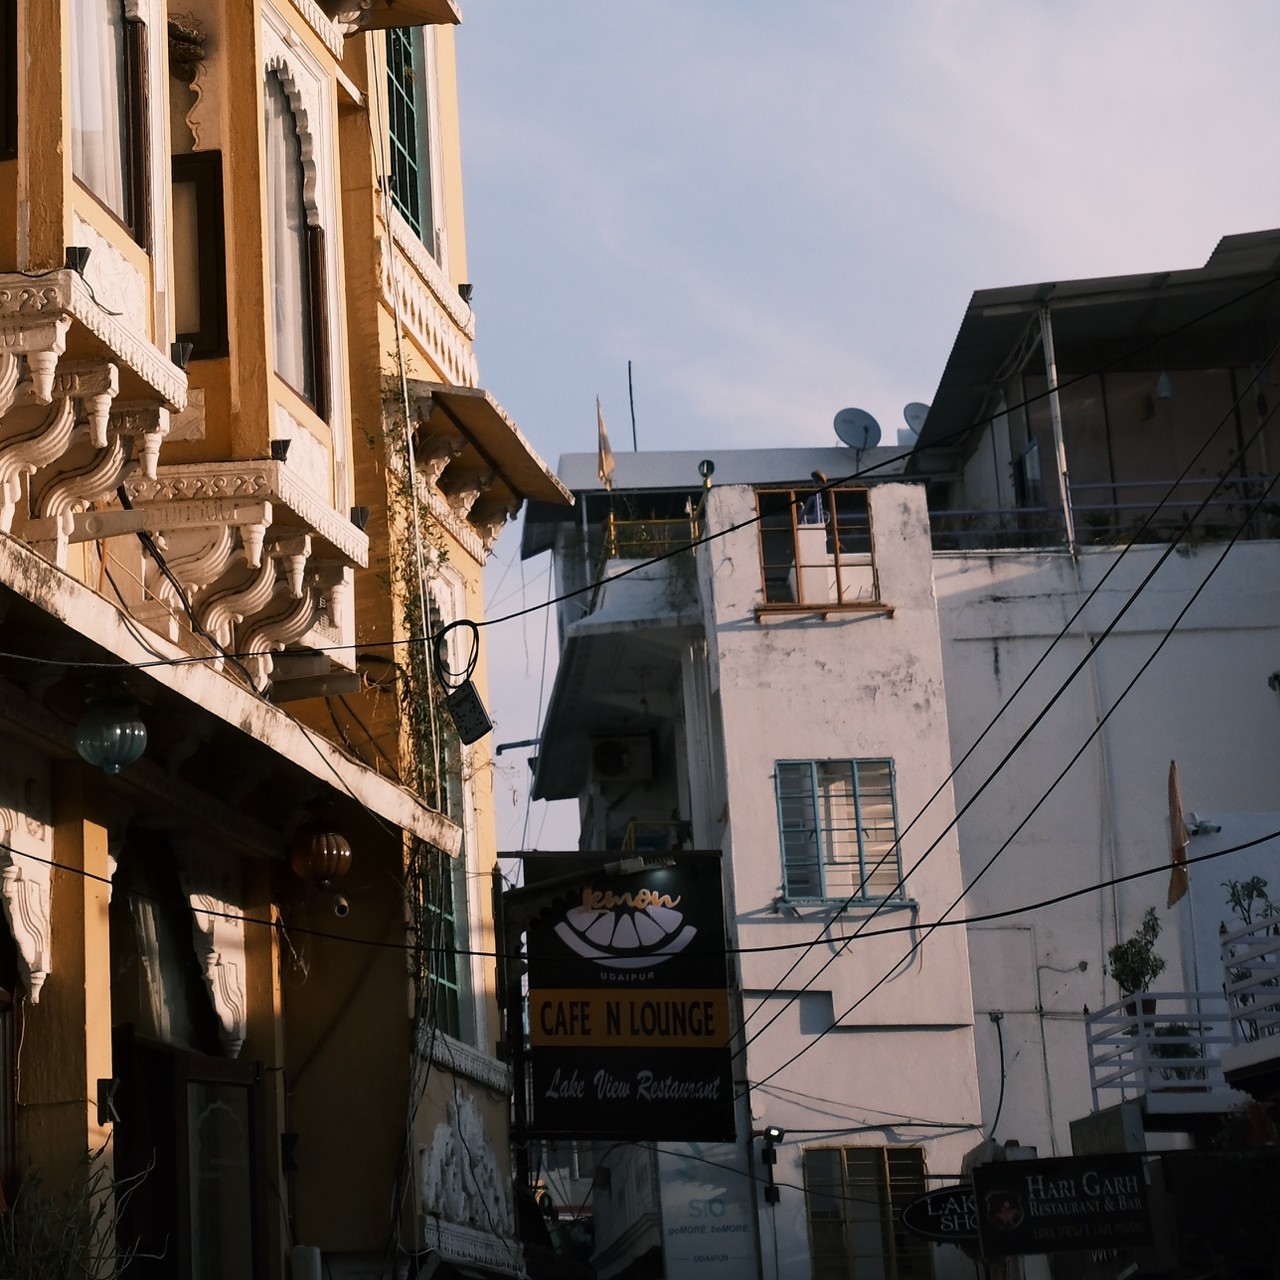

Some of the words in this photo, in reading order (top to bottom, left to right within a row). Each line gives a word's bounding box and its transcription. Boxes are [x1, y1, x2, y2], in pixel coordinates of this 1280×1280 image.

[581, 885, 681, 913] lemon
[600, 971, 655, 981] UDAIPUR
[540, 1000, 591, 1036] CAFE
[606, 1000, 620, 1036] N
[630, 1000, 715, 1036] LOUNGE
[545, 1067, 585, 1100] Lake
[593, 1068, 631, 1100] View
[636, 1069, 720, 1101] Restaurant
[1104, 1196, 1115, 1212] &
[693, 1254, 729, 1262] UDAIPUR
